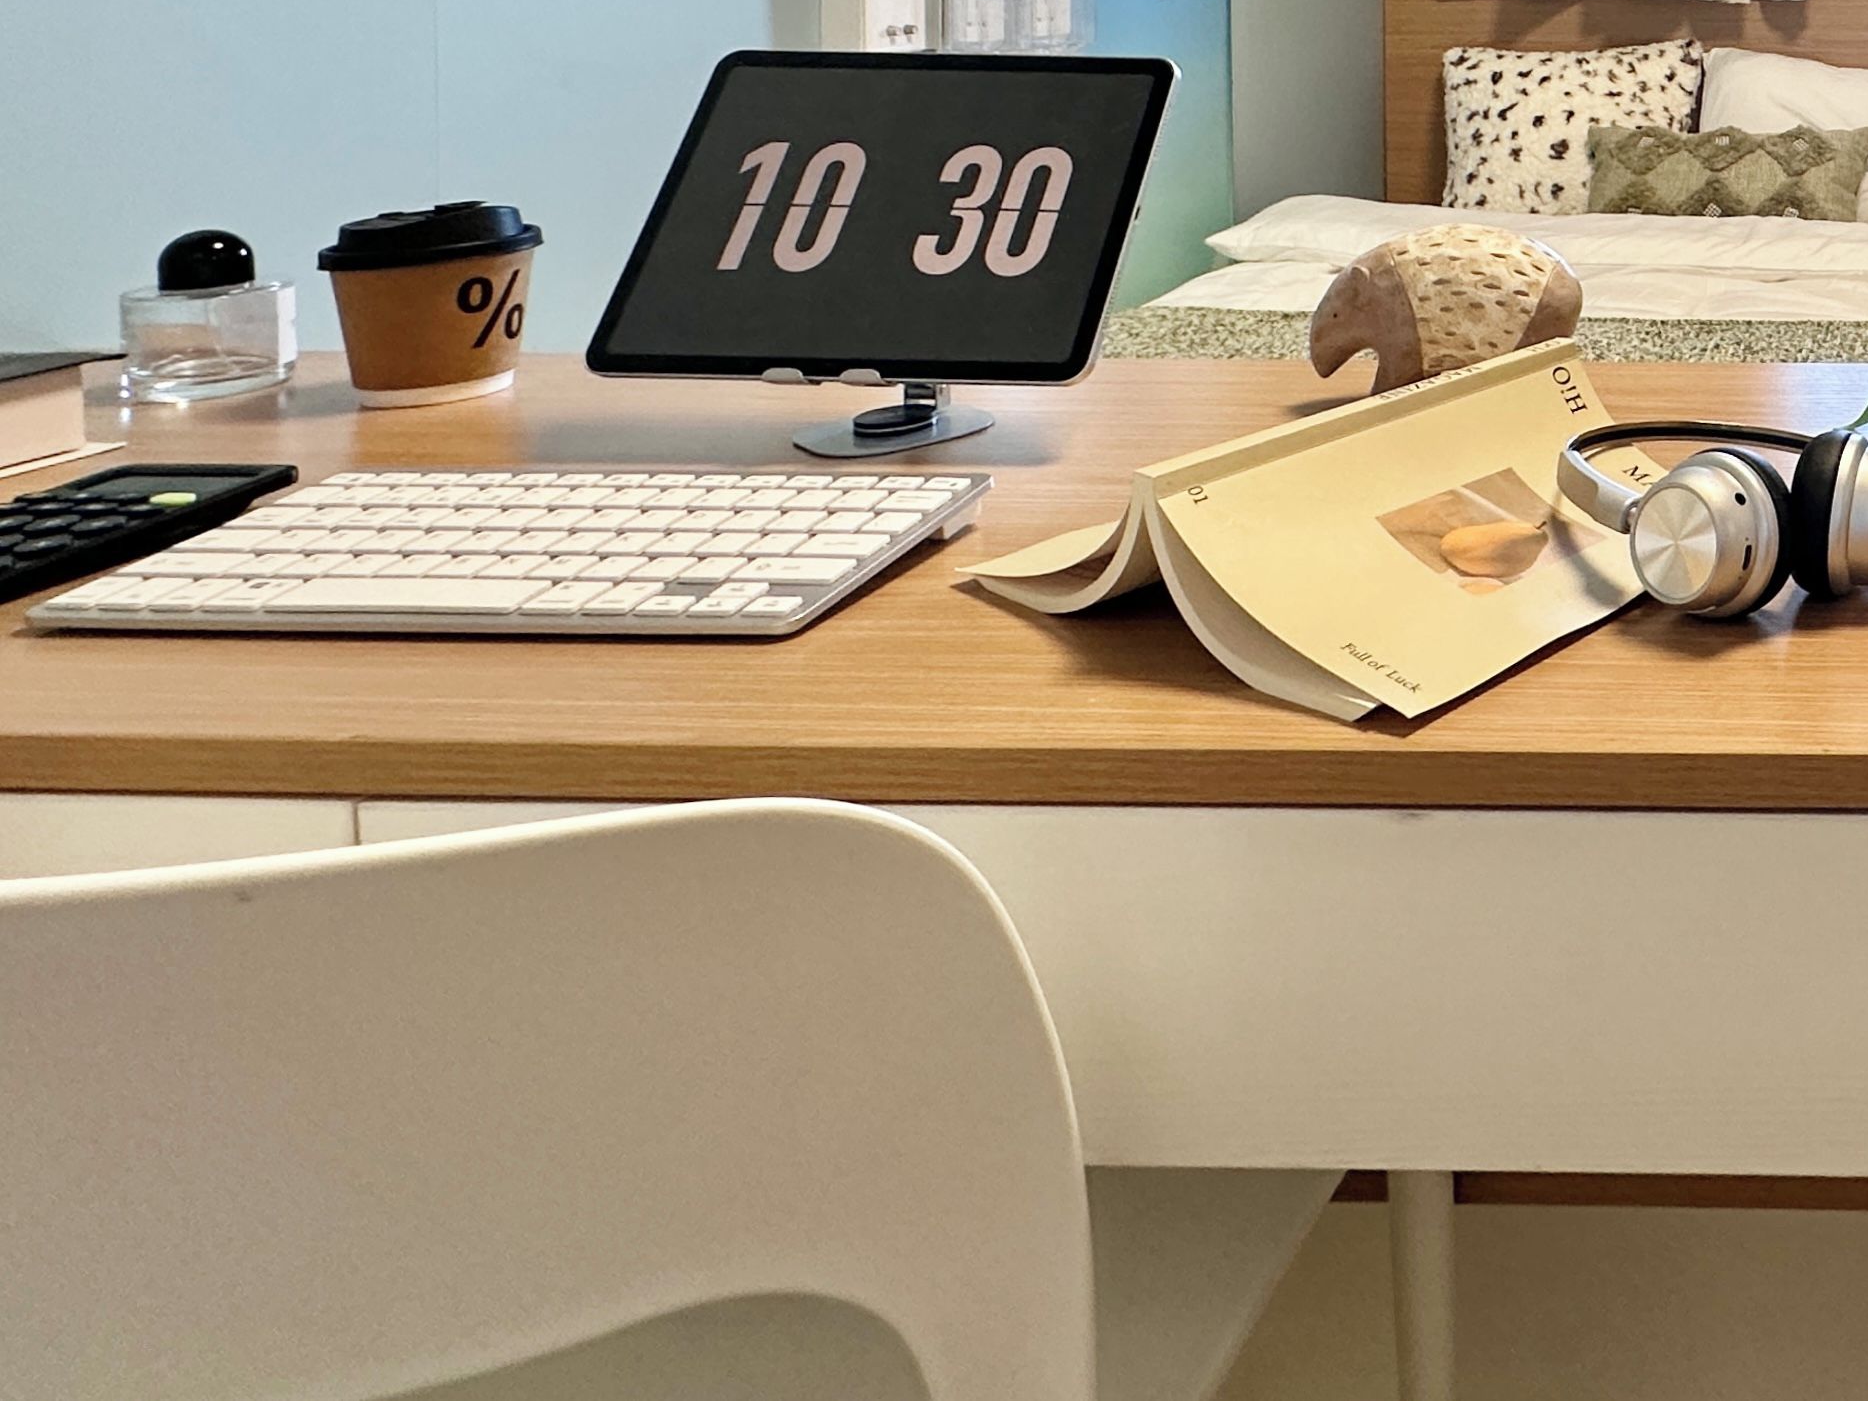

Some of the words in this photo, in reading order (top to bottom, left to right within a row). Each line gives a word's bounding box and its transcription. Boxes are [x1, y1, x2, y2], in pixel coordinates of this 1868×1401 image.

[716, 141, 867, 273] 10
[912, 144, 1074, 278] 30
[1188, 485, 1209, 505] 01
[1340, 642, 1373, 662] Full
[1367, 660, 1390, 671] of
[1385, 670, 1422, 694] Luck
